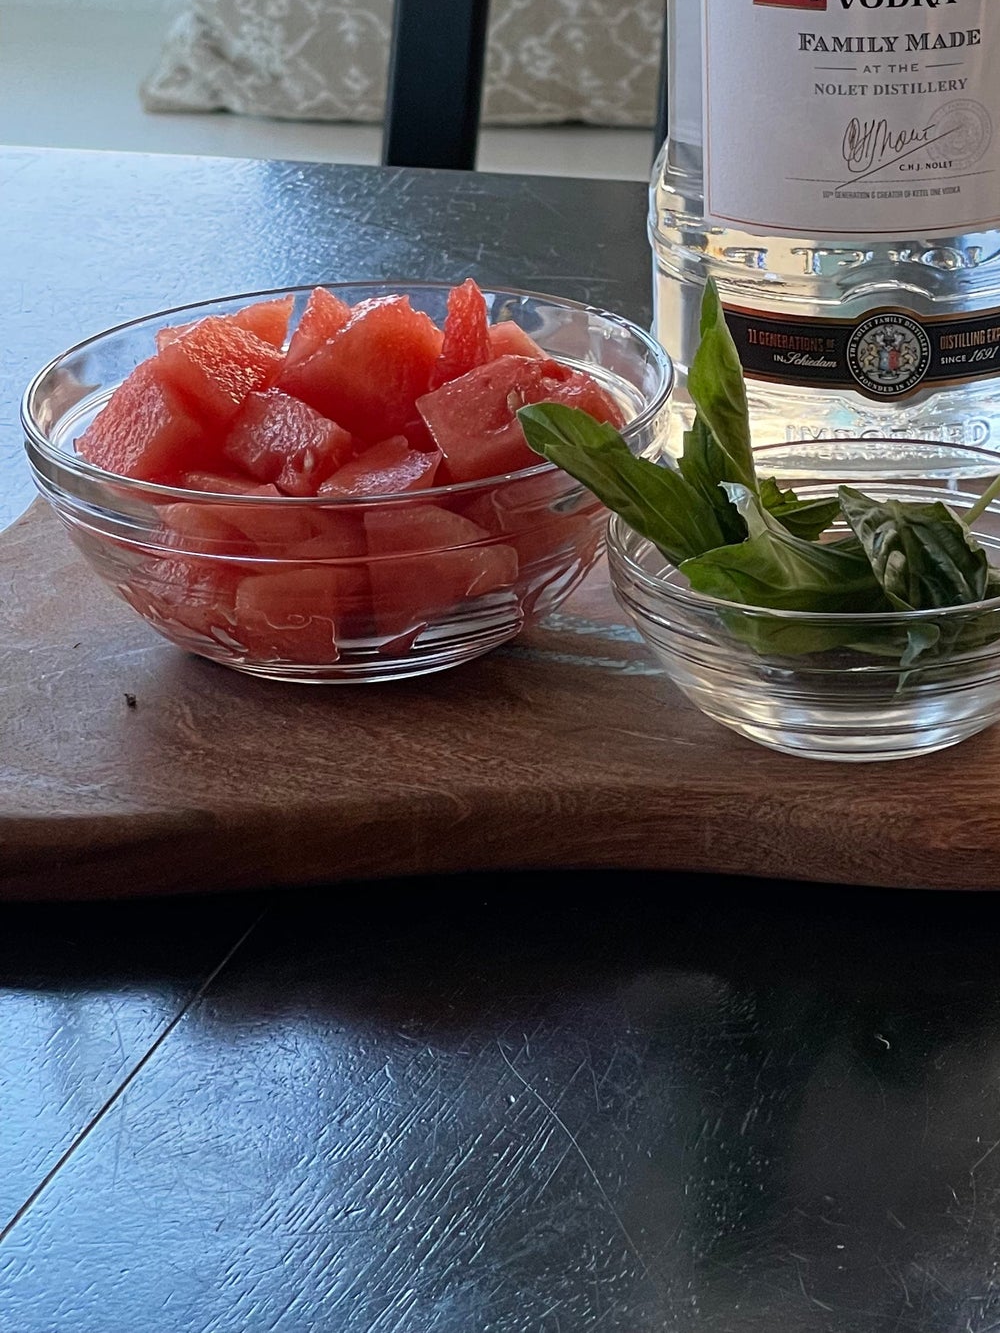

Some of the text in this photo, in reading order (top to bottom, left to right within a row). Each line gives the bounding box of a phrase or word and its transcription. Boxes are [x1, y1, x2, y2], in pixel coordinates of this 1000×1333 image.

[798, 28, 981, 53] FAMILY MADE
[863, 63, 919, 74] AT THE
[814, 78, 968, 96] NOLET DISTILLERY
[926, 160, 953, 169] NOLET
[874, 317, 902, 325] FAMILY
[747, 328, 757, 344] 11
[759, 330, 823, 352] GENERATIONS
[940, 329, 986, 350] DISTILLING
[773, 351, 837, 367] IN Schiedam
[940, 345, 999, 364] SINCE 1691
